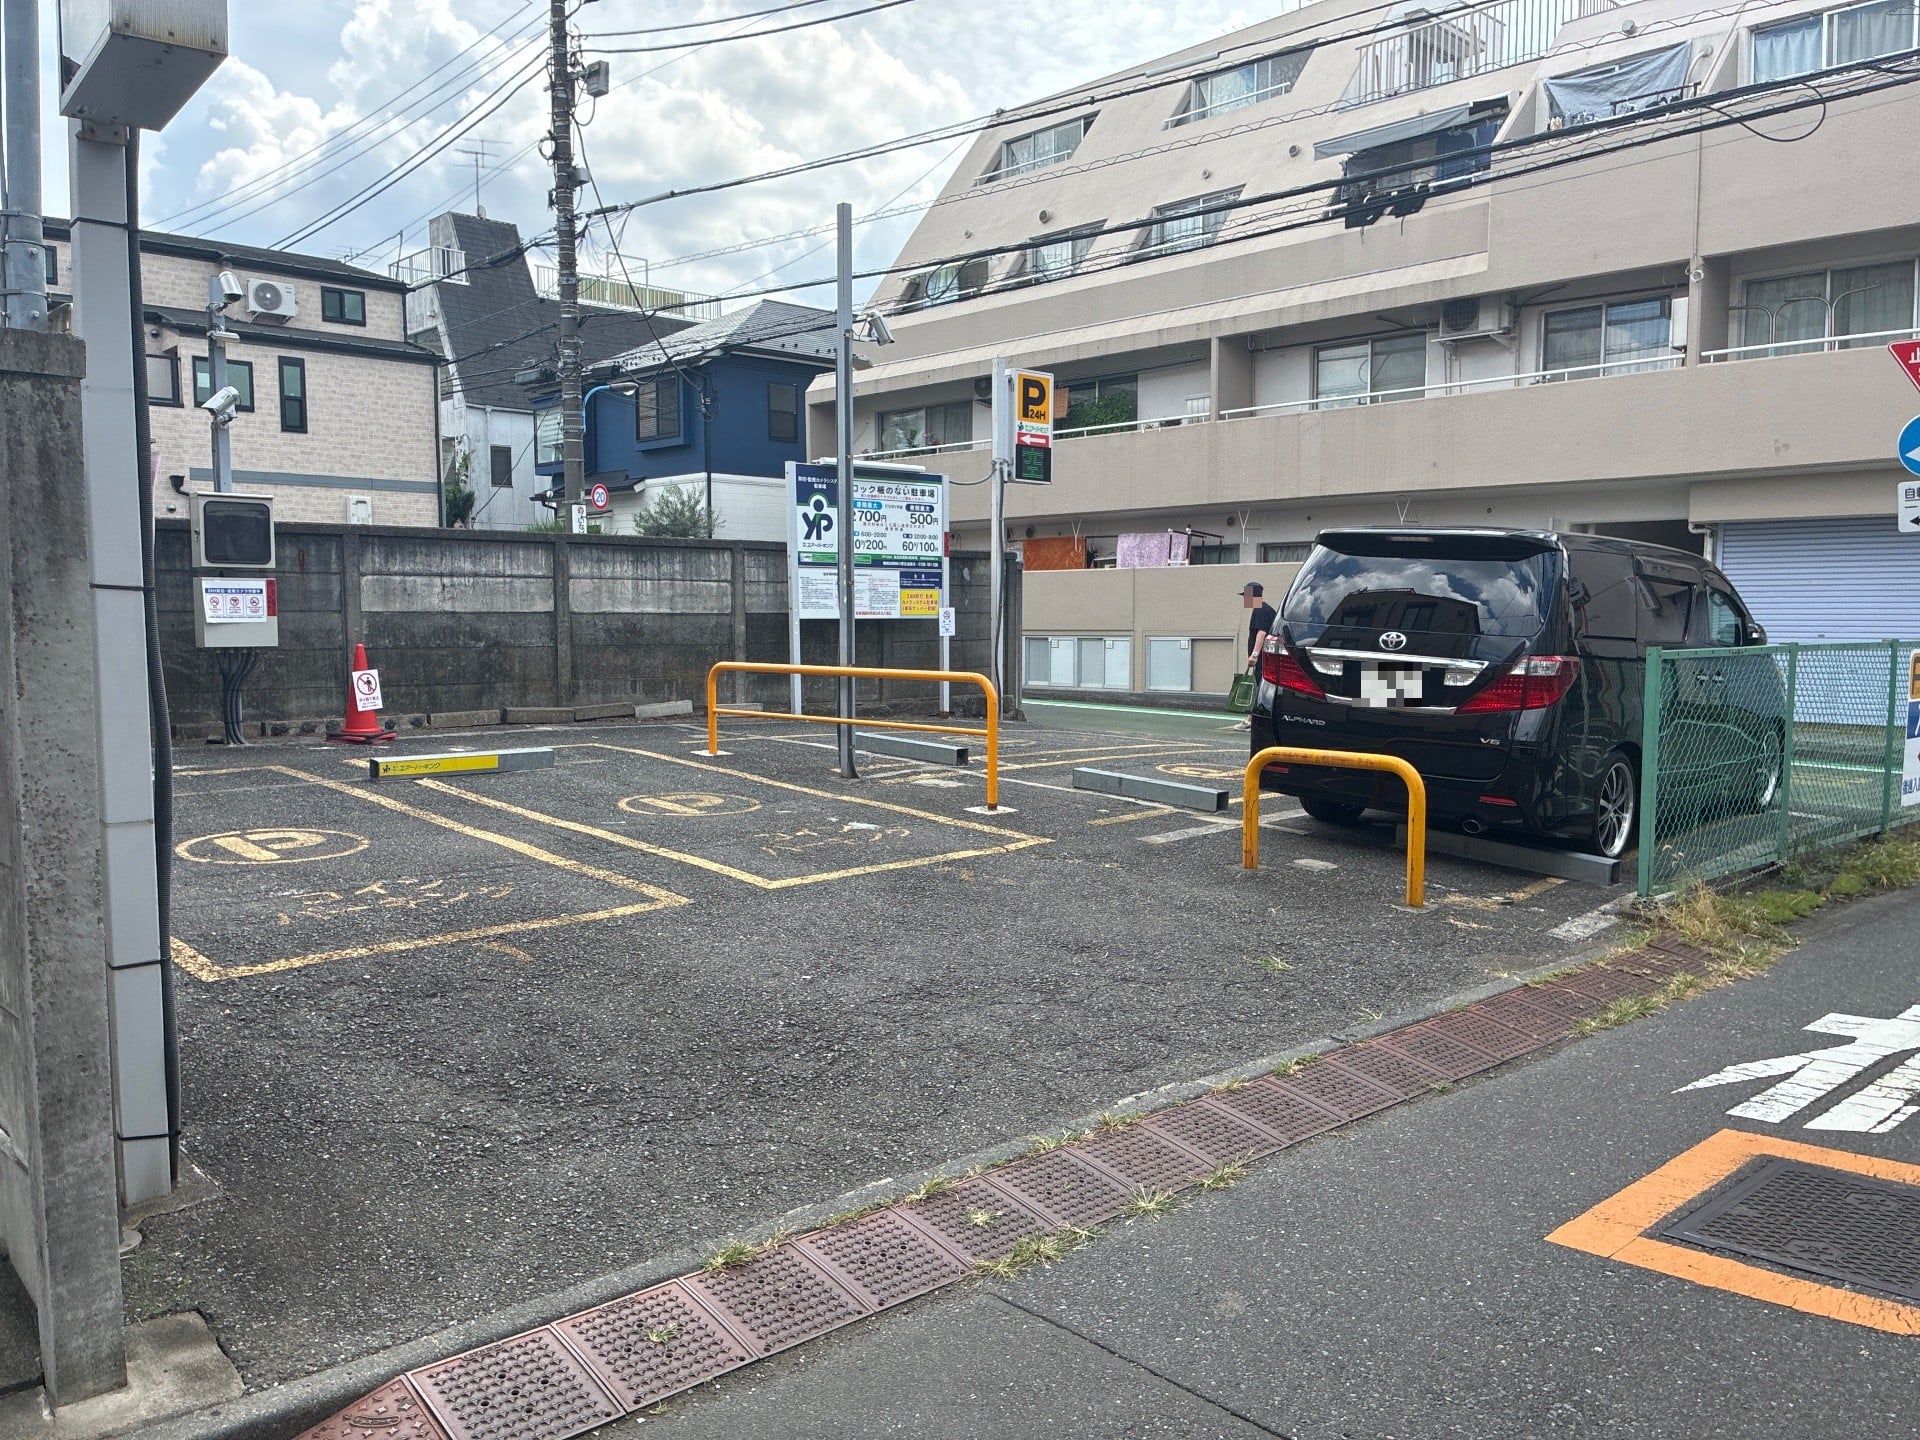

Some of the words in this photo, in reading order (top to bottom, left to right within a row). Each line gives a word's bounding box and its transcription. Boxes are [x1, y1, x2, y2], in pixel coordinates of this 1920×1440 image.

[1023, 378, 1046, 418] P
[1029, 409, 1046, 420] 24H
[595, 491, 606, 503] 20
[910, 513, 939, 526] 500円
[1281, 714, 1326, 727] ALPHARD
[1479, 737, 1501, 746] V6
[213, 831, 327, 861] P
